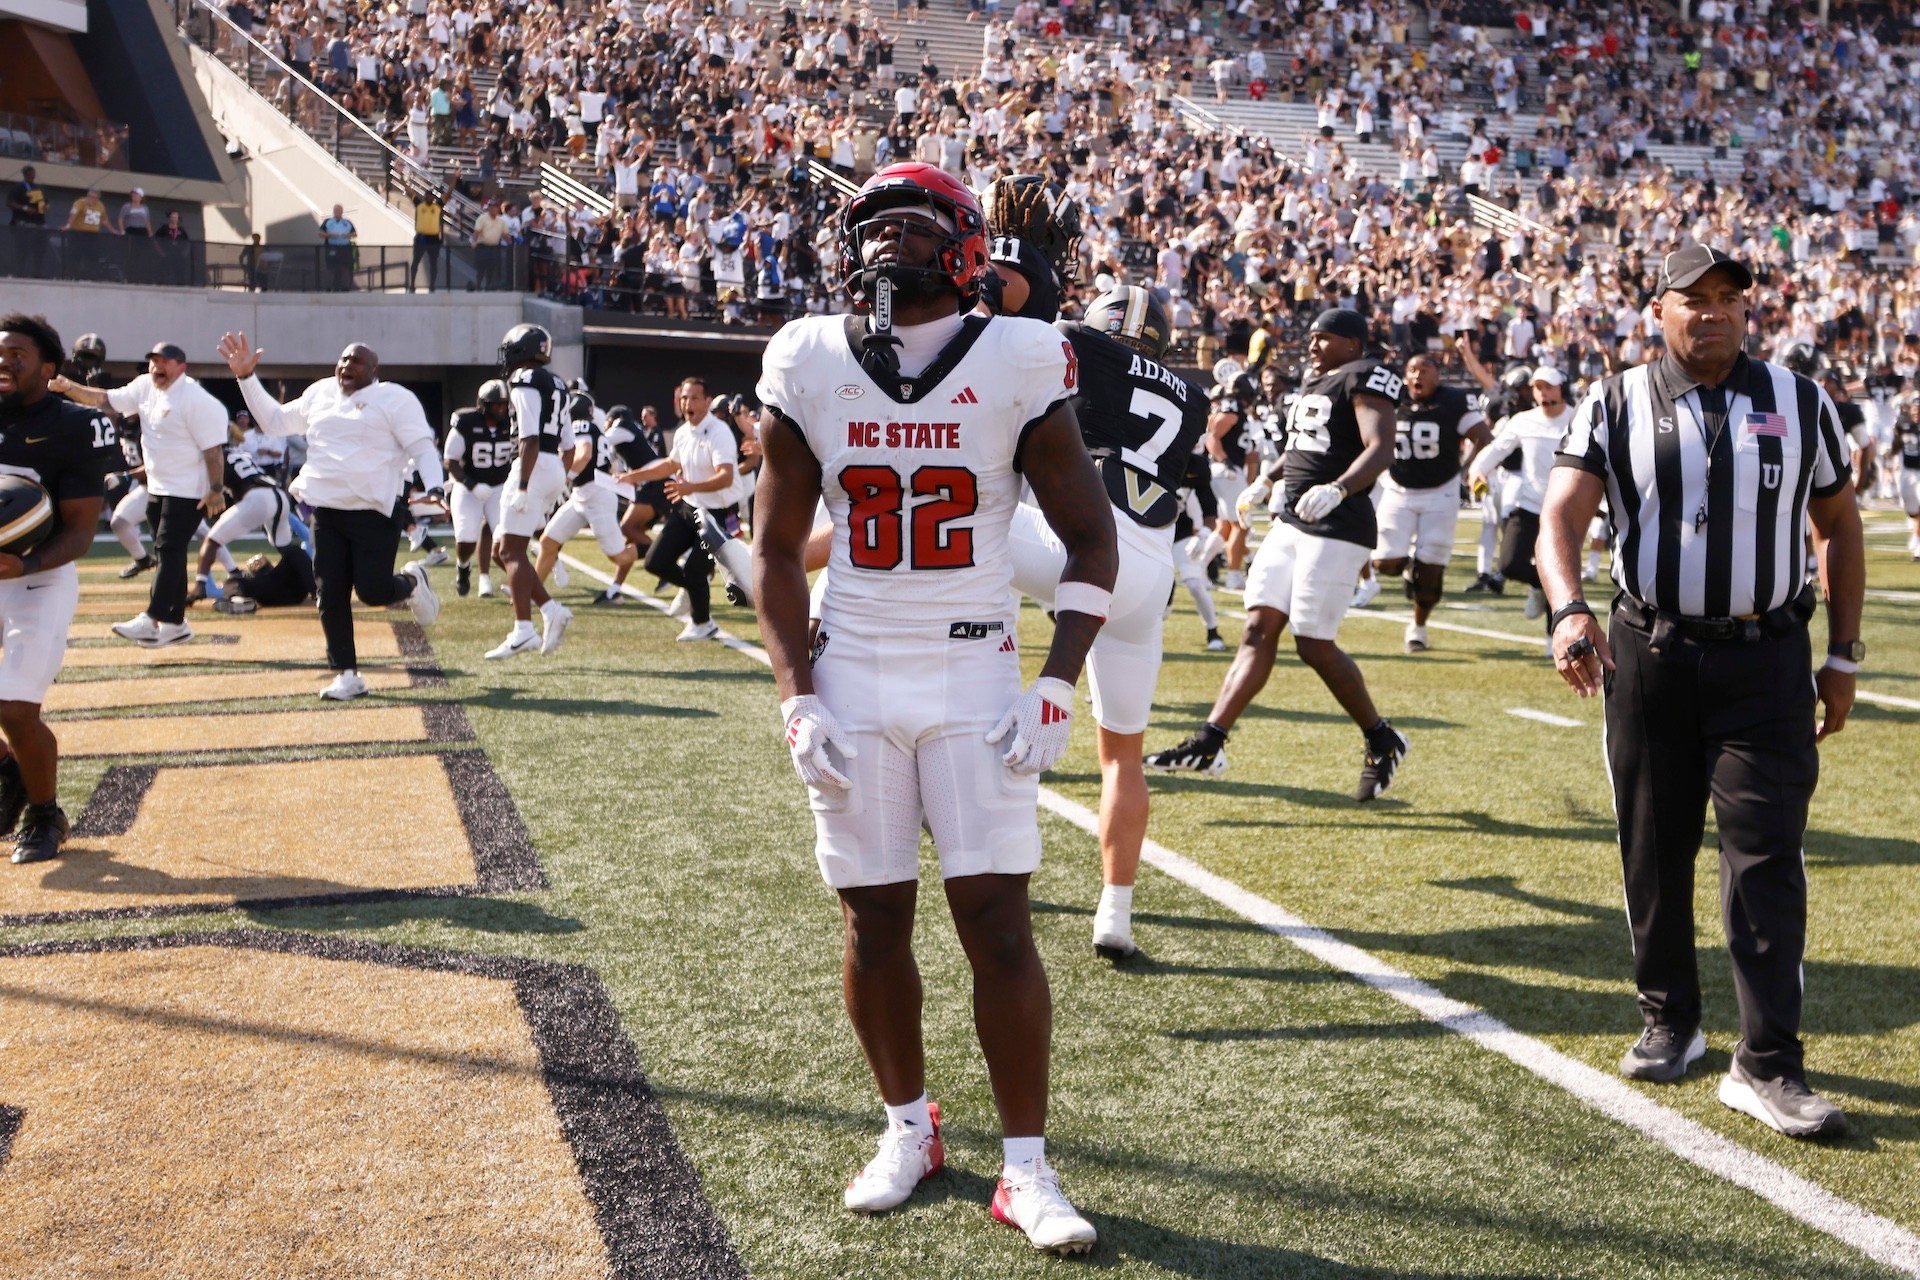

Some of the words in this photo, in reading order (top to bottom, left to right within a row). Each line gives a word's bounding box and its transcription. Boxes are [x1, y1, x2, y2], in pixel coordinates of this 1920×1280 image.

[990, 237, 1020, 264] 11
[879, 281, 888, 326] BATTLE
[1109, 320, 1121, 331] SEC
[841, 387, 860, 395] ACC
[1127, 354, 1187, 402] ADAMS
[1365, 365, 1403, 400] 28
[90, 416, 115, 448] 12
[848, 422, 880, 447] NC
[886, 422, 961, 448] STATE
[1121, 387, 1183, 477] 7
[1658, 417, 1675, 433] S
[472, 441, 512, 469] 65
[1393, 421, 1440, 460] 58
[1763, 463, 1781, 489] U
[838, 465, 978, 570] 82
